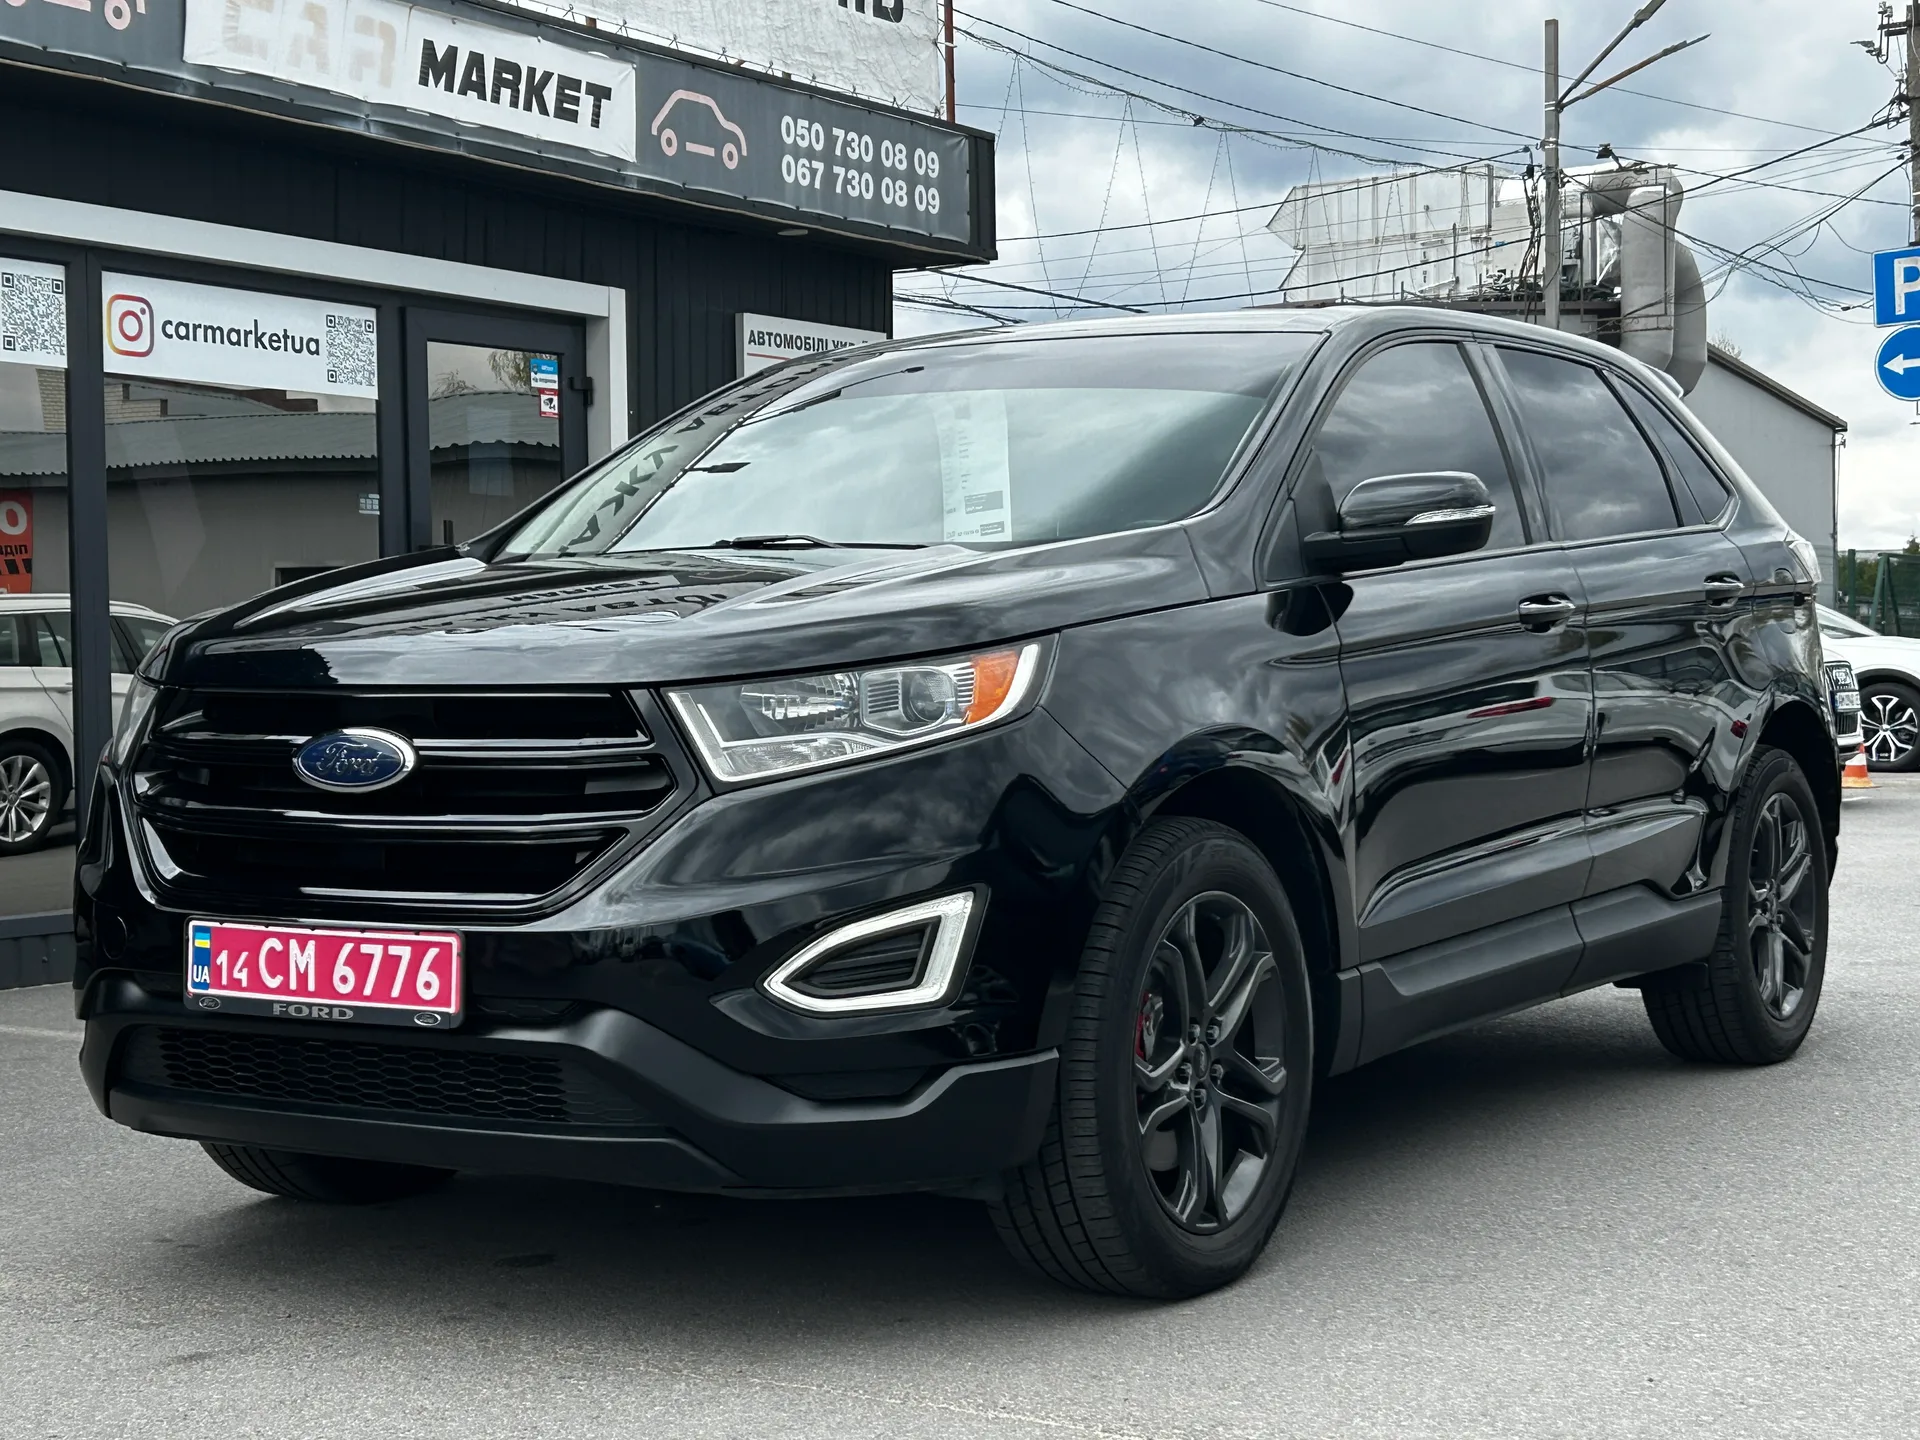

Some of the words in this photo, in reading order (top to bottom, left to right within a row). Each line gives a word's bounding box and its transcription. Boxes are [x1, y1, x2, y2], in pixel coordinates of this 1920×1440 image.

[419, 38, 612, 129] MARKET
[780, 115, 825, 151] 050
[832, 127, 873, 163] 730
[880, 139, 907, 171] 08
[914, 148, 940, 178] 09
[781, 154, 825, 190] 067
[832, 166, 874, 200] 730
[881, 177, 907, 207] 08
[914, 184, 940, 214] 09
[1894, 256, 1920, 315] P
[161, 318, 321, 356] carmarketua
[748, 329, 828, 352] АВТОМОБІЛІ
[315, 741, 383, 776] Ford
[193, 964, 210, 984] UA
[215, 949, 249, 988] 14
[258, 937, 316, 992] CM
[332, 942, 440, 1001] 6776
[272, 1002, 354, 1020] FORD
